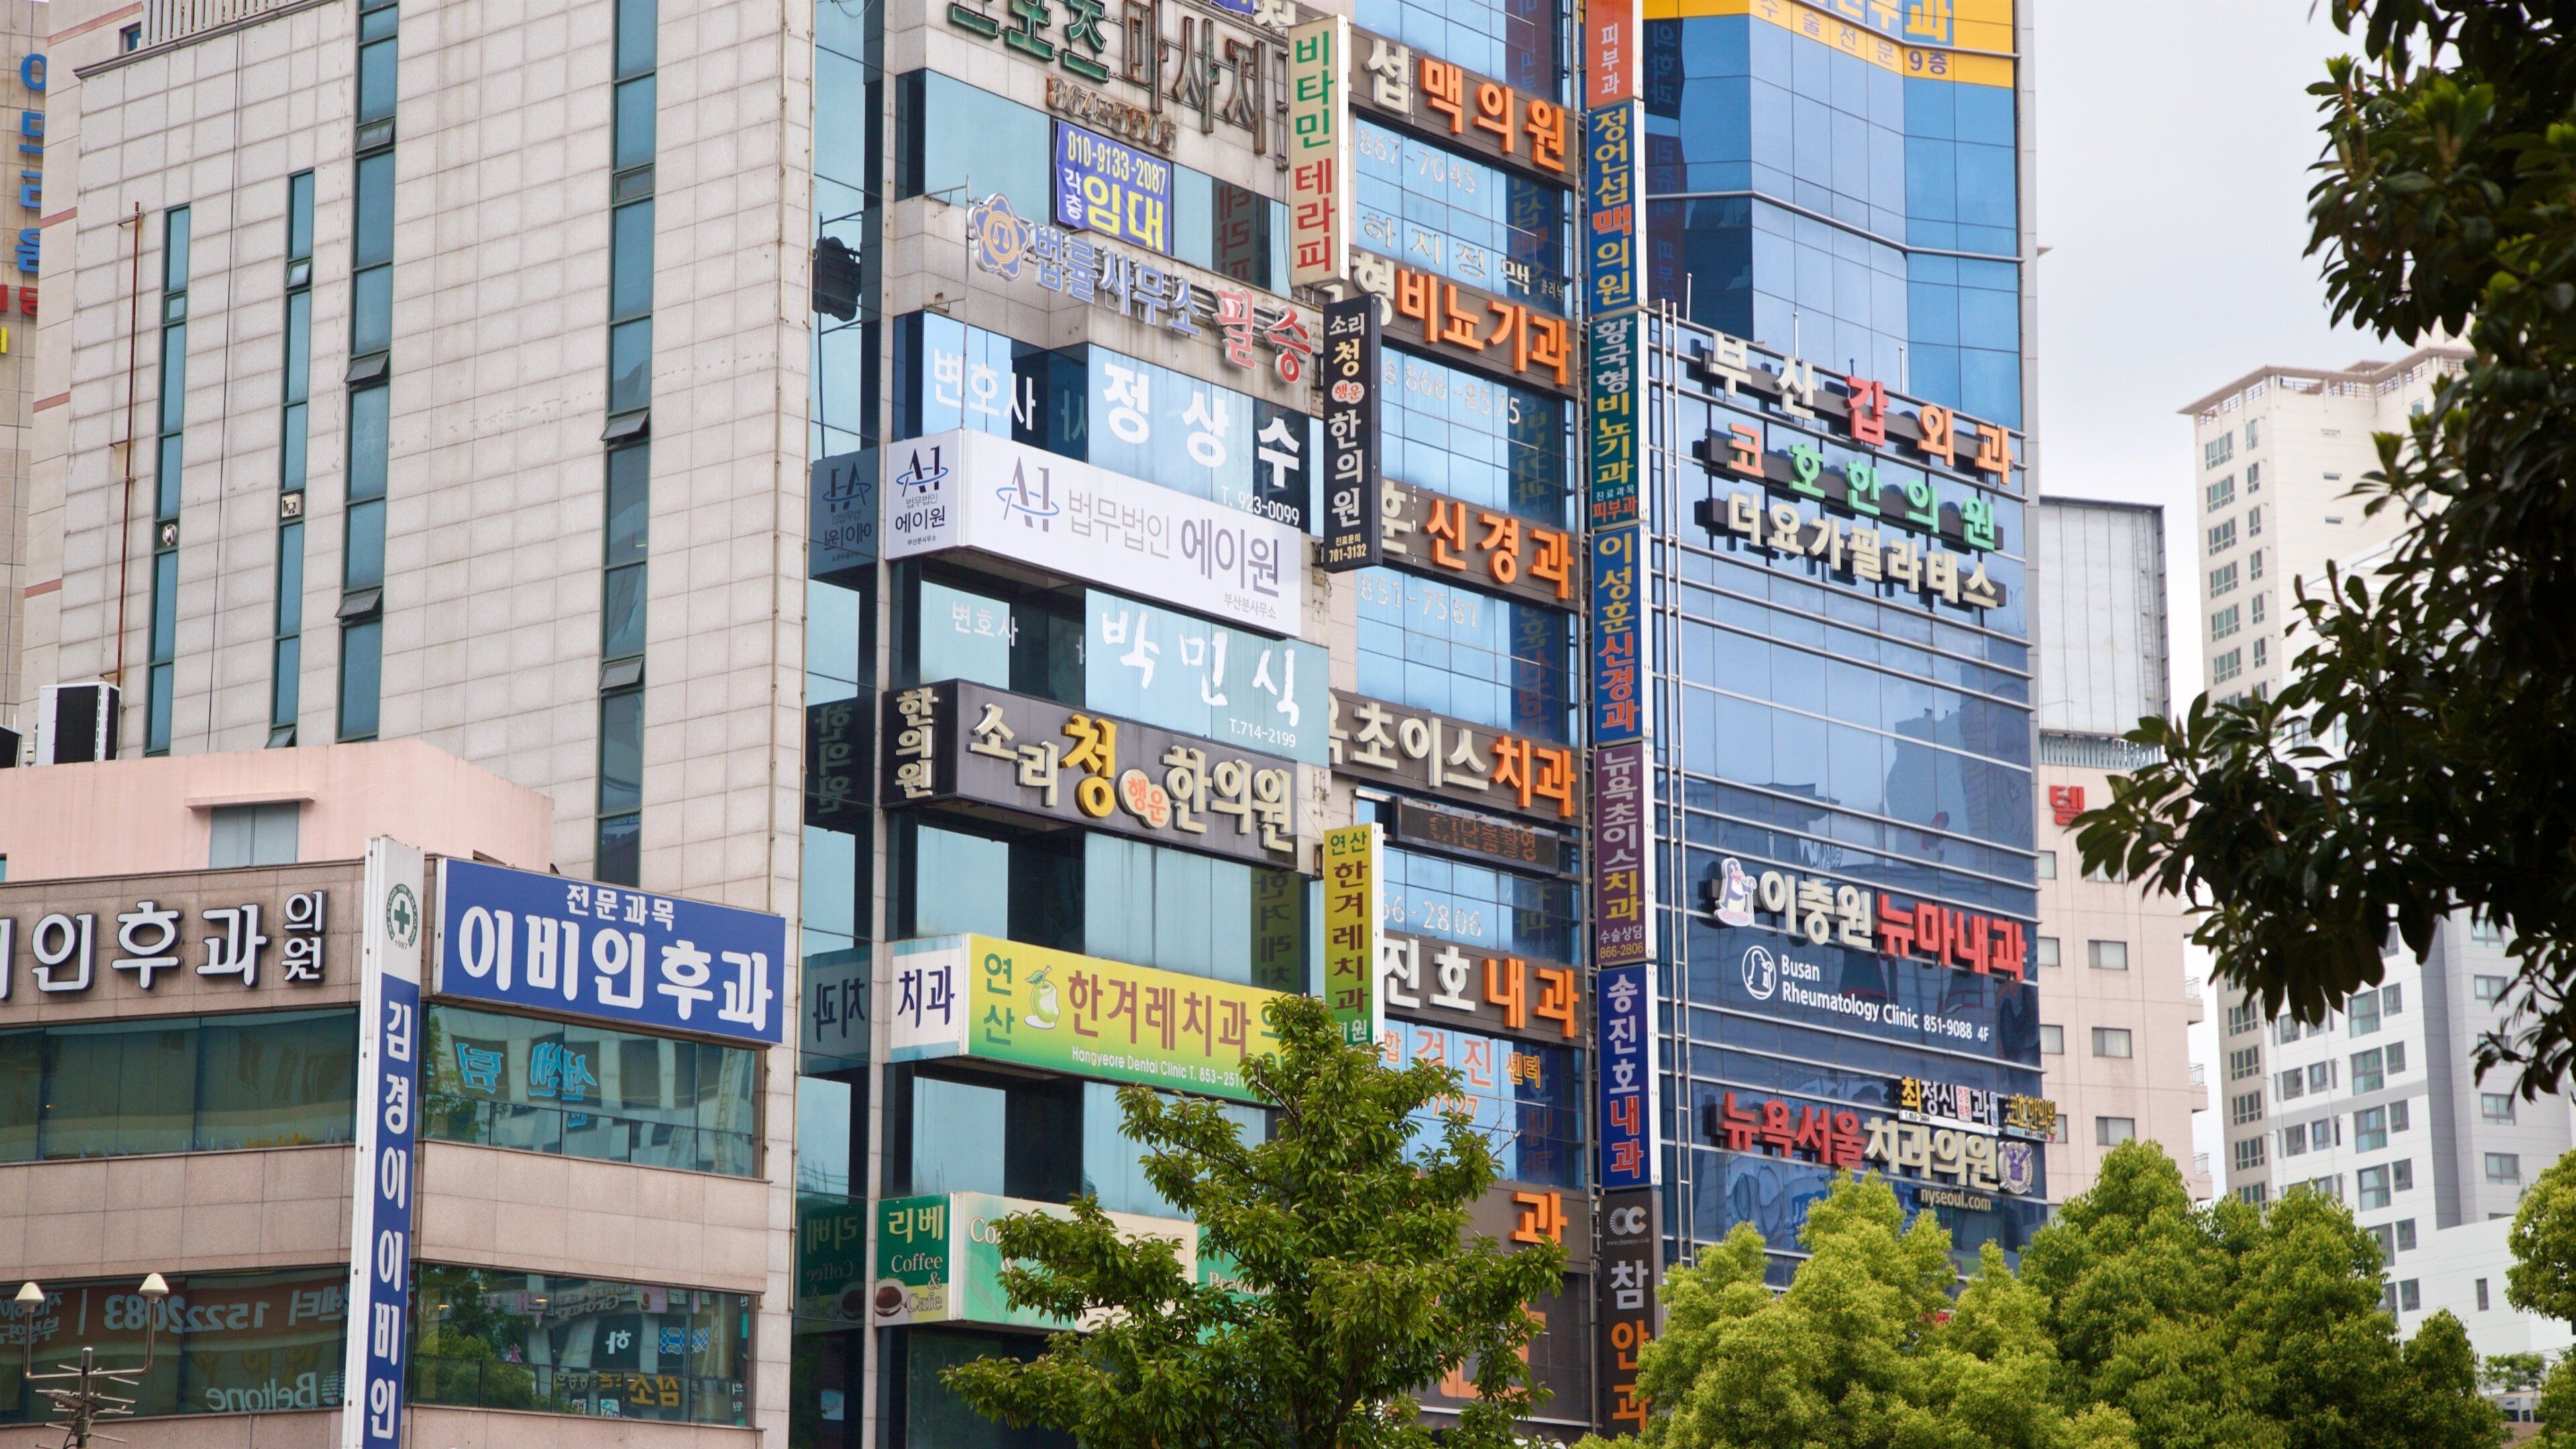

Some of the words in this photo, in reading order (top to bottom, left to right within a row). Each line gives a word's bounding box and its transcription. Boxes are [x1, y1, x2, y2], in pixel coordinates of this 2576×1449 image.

[1601, 23, 1619, 94] 피부과
[1909, 50, 1948, 75] 9층
[1046, 77, 1178, 154] 864-5505
[1364, 38, 1565, 174] 섭맥의원
[1067, 130, 1167, 196] 010-9133-2087
[1358, 127, 1477, 195] 867-7045
[1064, 168, 1083, 221] 각종
[1083, 176, 1165, 254] 임대
[1593, 110, 1632, 307] 정언섭맥의원
[1032, 223, 1200, 335] 법률사무소
[1214, 287, 1313, 384] 필승
[1329, 313, 1364, 335] 소리
[1333, 338, 1360, 376] 청
[933, 347, 1036, 430] 변호사
[1335, 383, 1362, 400] 행운
[1405, 364, 1520, 424] 866-8575
[1328, 409, 1364, 527] 한의원
[1596, 484, 1634, 501] 진료과목
[1727, 422, 1995, 551] 코호한의원
[895, 504, 945, 533] 에이원
[906, 492, 938, 508] 법무법인
[1238, 493, 1300, 527] 923-0099
[1593, 495, 1638, 523] 피부과
[1068, 488, 1169, 559] 법무법인
[1181, 517, 1279, 598] 에이원
[1329, 543, 1366, 563] 701-3132
[952, 601, 1019, 647] 변호사
[1224, 591, 1277, 620] 부산분사무소
[1360, 573, 1477, 629] 851-7581
[1598, 532, 1640, 732] 이성훈신경과
[895, 687, 938, 800] 한의원
[1228, 718, 1297, 748] T.714-2199
[1127, 777, 1167, 824] 행운
[1163, 745, 1293, 852] 한의원
[1330, 830, 1366, 856] 연산
[1601, 752, 1643, 922] 뉴욕초이스치과
[280, 890, 325, 981] 의원
[567, 884, 674, 931] 전문과목
[1600, 924, 1643, 944] 수술상담
[1332, 860, 1368, 1014] 한겨레치과
[1600, 942, 1644, 959] 866-2806
[459, 906, 773, 1031] 이비인후과
[1782, 954, 1820, 982] Busan
[897, 965, 955, 1029] 치과
[983, 953, 1015, 1046] 연산
[1068, 970, 1252, 1060] 한겨레치과
[1782, 981, 1879, 1021] Rheumatology
[1882, 1004, 1918, 1029] Clinic
[1923, 1015, 1972, 1039] 851-9088
[1977, 1026, 1989, 1042] 4F
[1073, 1044, 1125, 1069] Hangyeore
[1127, 1055, 1158, 1074] Dental
[1161, 1061, 1187, 1079] Clinic
[1607, 974, 1644, 1179] 송진호내과
[888, 1205, 945, 1243] 리베
[1921, 1188, 1991, 1212] nyseoul.com
[891, 1252, 943, 1274] Coffee
[927, 1272, 942, 1290] &
[906, 1292, 943, 1314] Cafe
